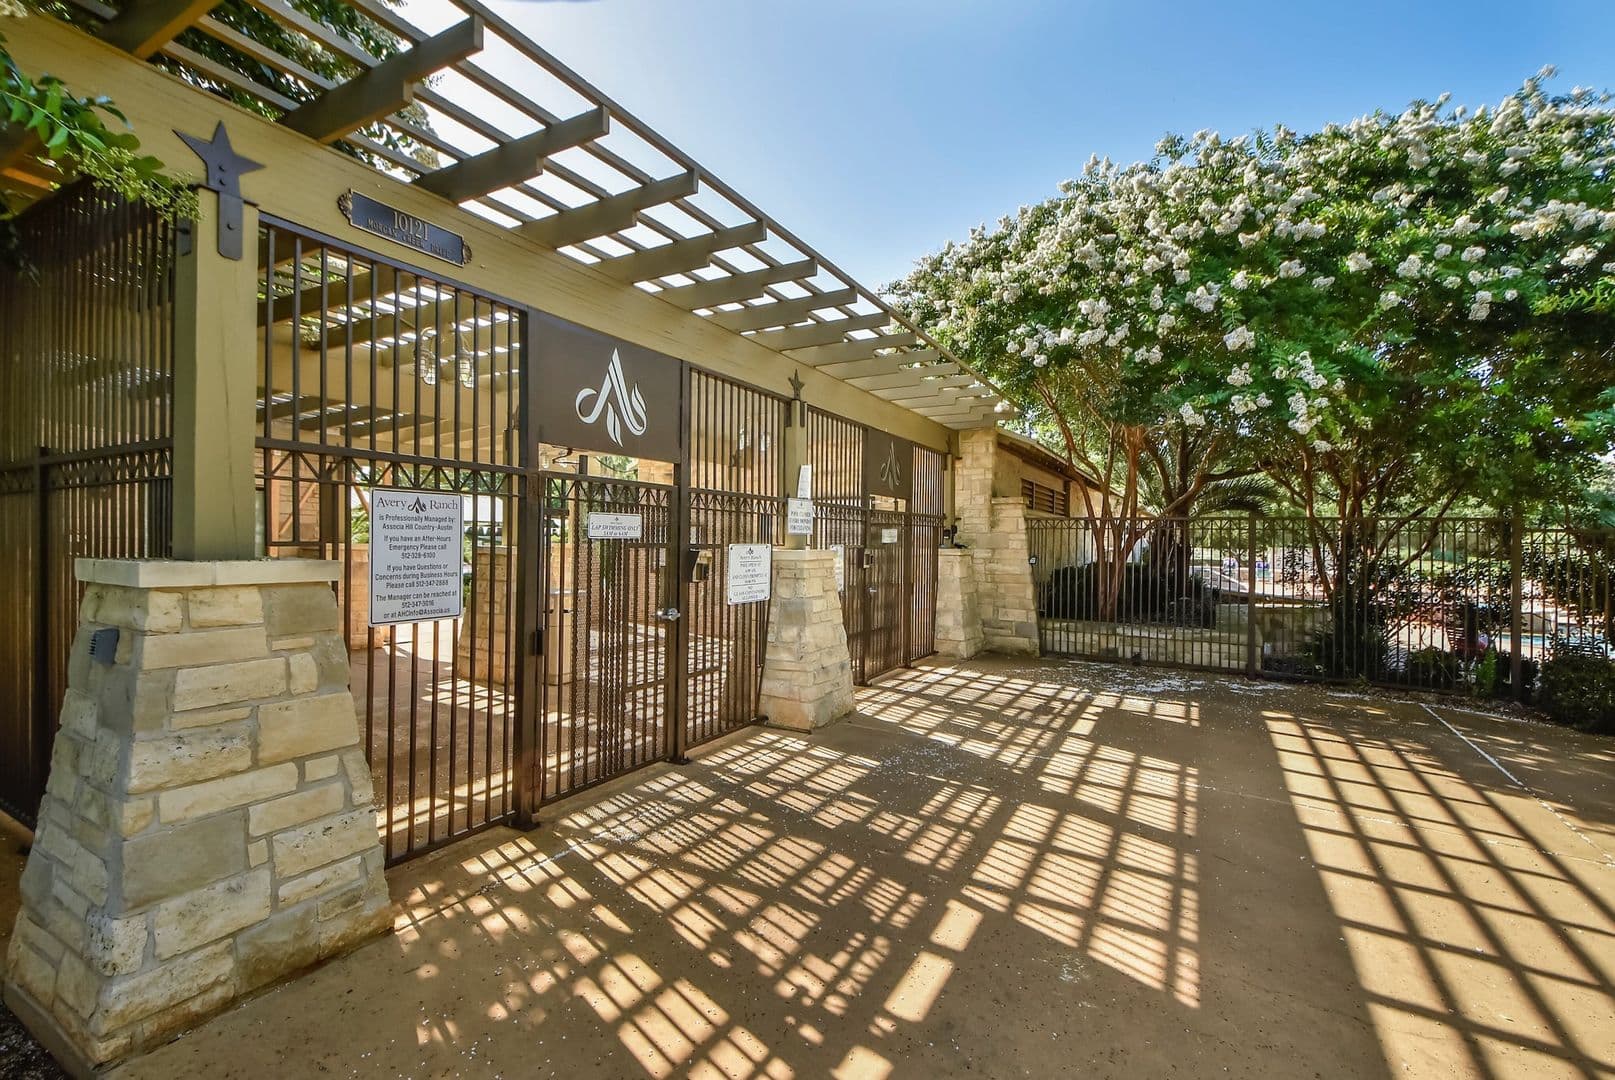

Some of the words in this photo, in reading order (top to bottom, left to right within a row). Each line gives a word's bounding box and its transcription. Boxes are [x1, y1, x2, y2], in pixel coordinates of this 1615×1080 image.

[368, 218, 398, 238] MORGAN
[393, 211, 429, 240] 10121
[376, 496, 406, 510] Avery
[429, 500, 458, 510] Ranch
[385, 514, 423, 523] Professionally
[424, 515, 447, 523] Managed
[416, 563, 442, 571] Questions
[375, 573, 402, 581] Concerns
[402, 572, 420, 580] during
[387, 593, 412, 601] Manager
[430, 590, 452, 598] reached
